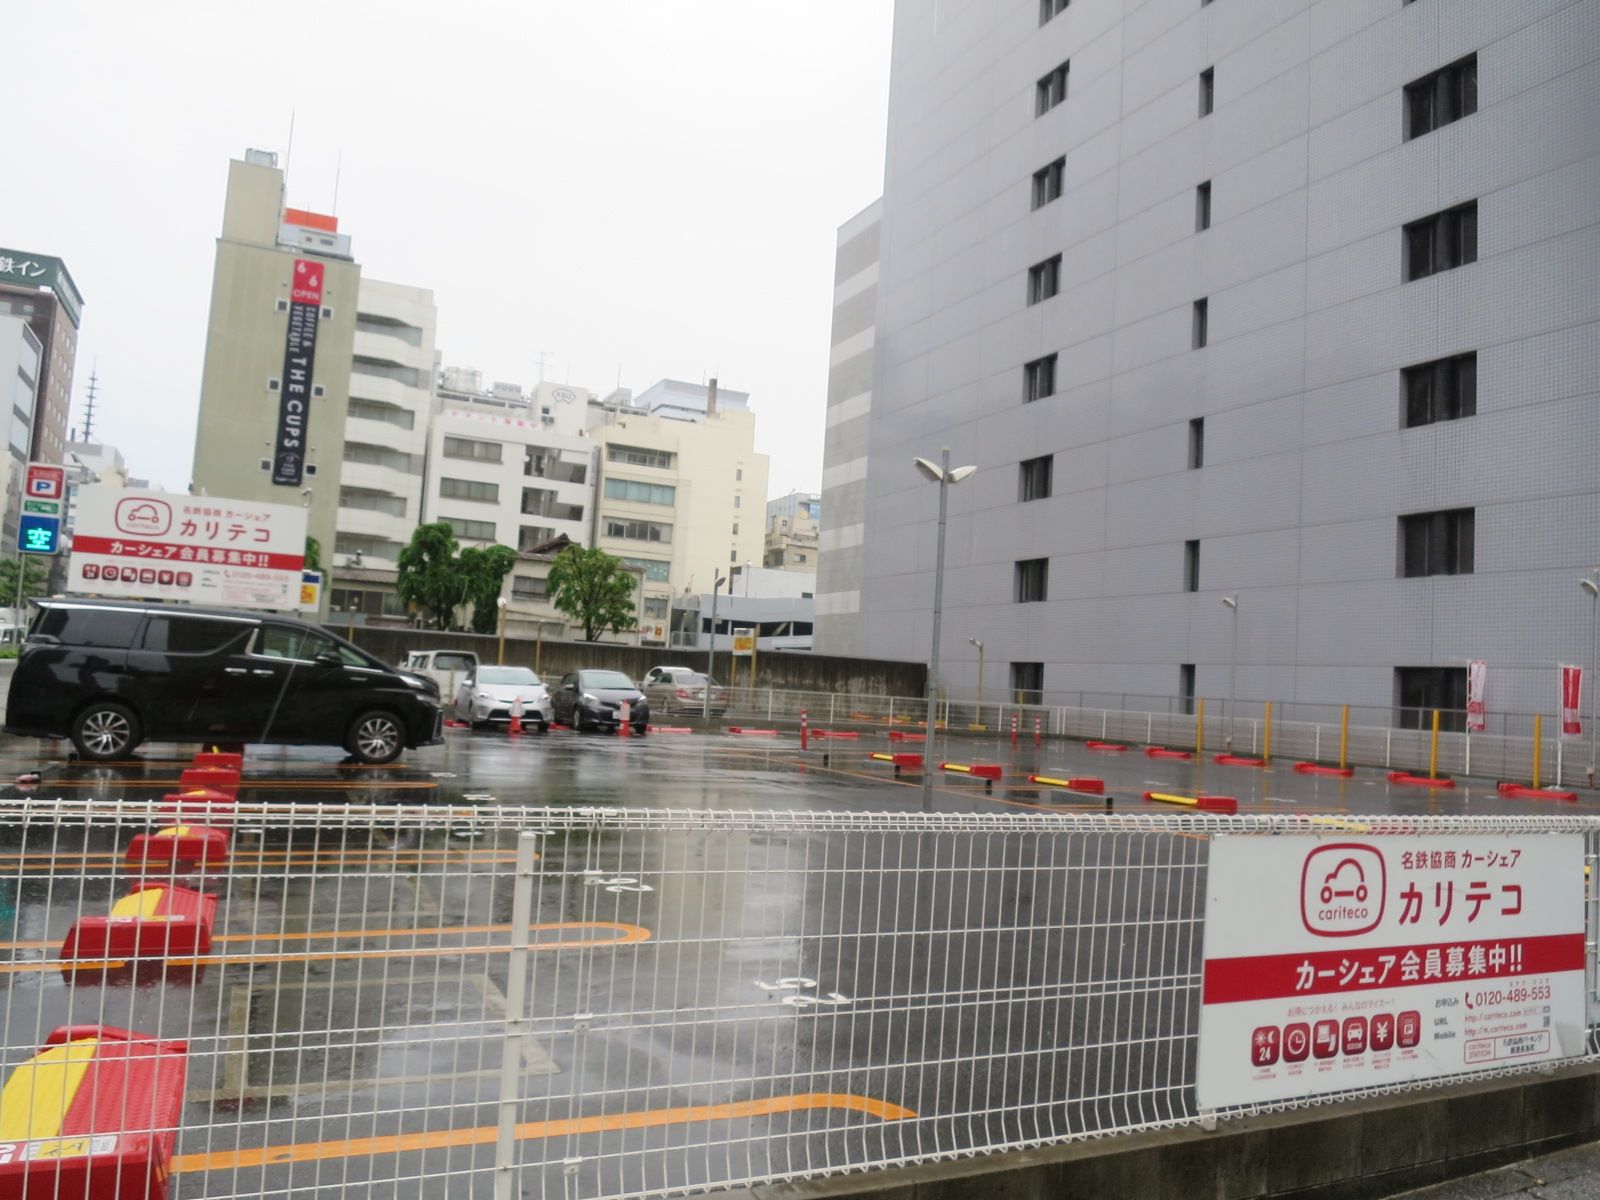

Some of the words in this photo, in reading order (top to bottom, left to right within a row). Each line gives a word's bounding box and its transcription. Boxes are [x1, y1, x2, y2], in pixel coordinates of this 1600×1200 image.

[293, 288, 320, 300] OPEN
[288, 357, 307, 393] THE
[283, 400, 304, 448] CUPS
[36, 481, 51, 492] P
[26, 527, 52, 550] 空
[180, 519, 270, 543] カリテコ
[1401, 851, 1457, 870] 名鉄協商
[1461, 849, 1521, 869] カーシェア
[1318, 905, 1368, 921] cariteco
[1398, 881, 1522, 927] カリテコ
[1475, 985, 1551, 1006] 0120-489-553
[1434, 1018, 1448, 1026] URL
[1434, 1030, 1456, 1040] Mobile
[1259, 1047, 1271, 1062] 24
